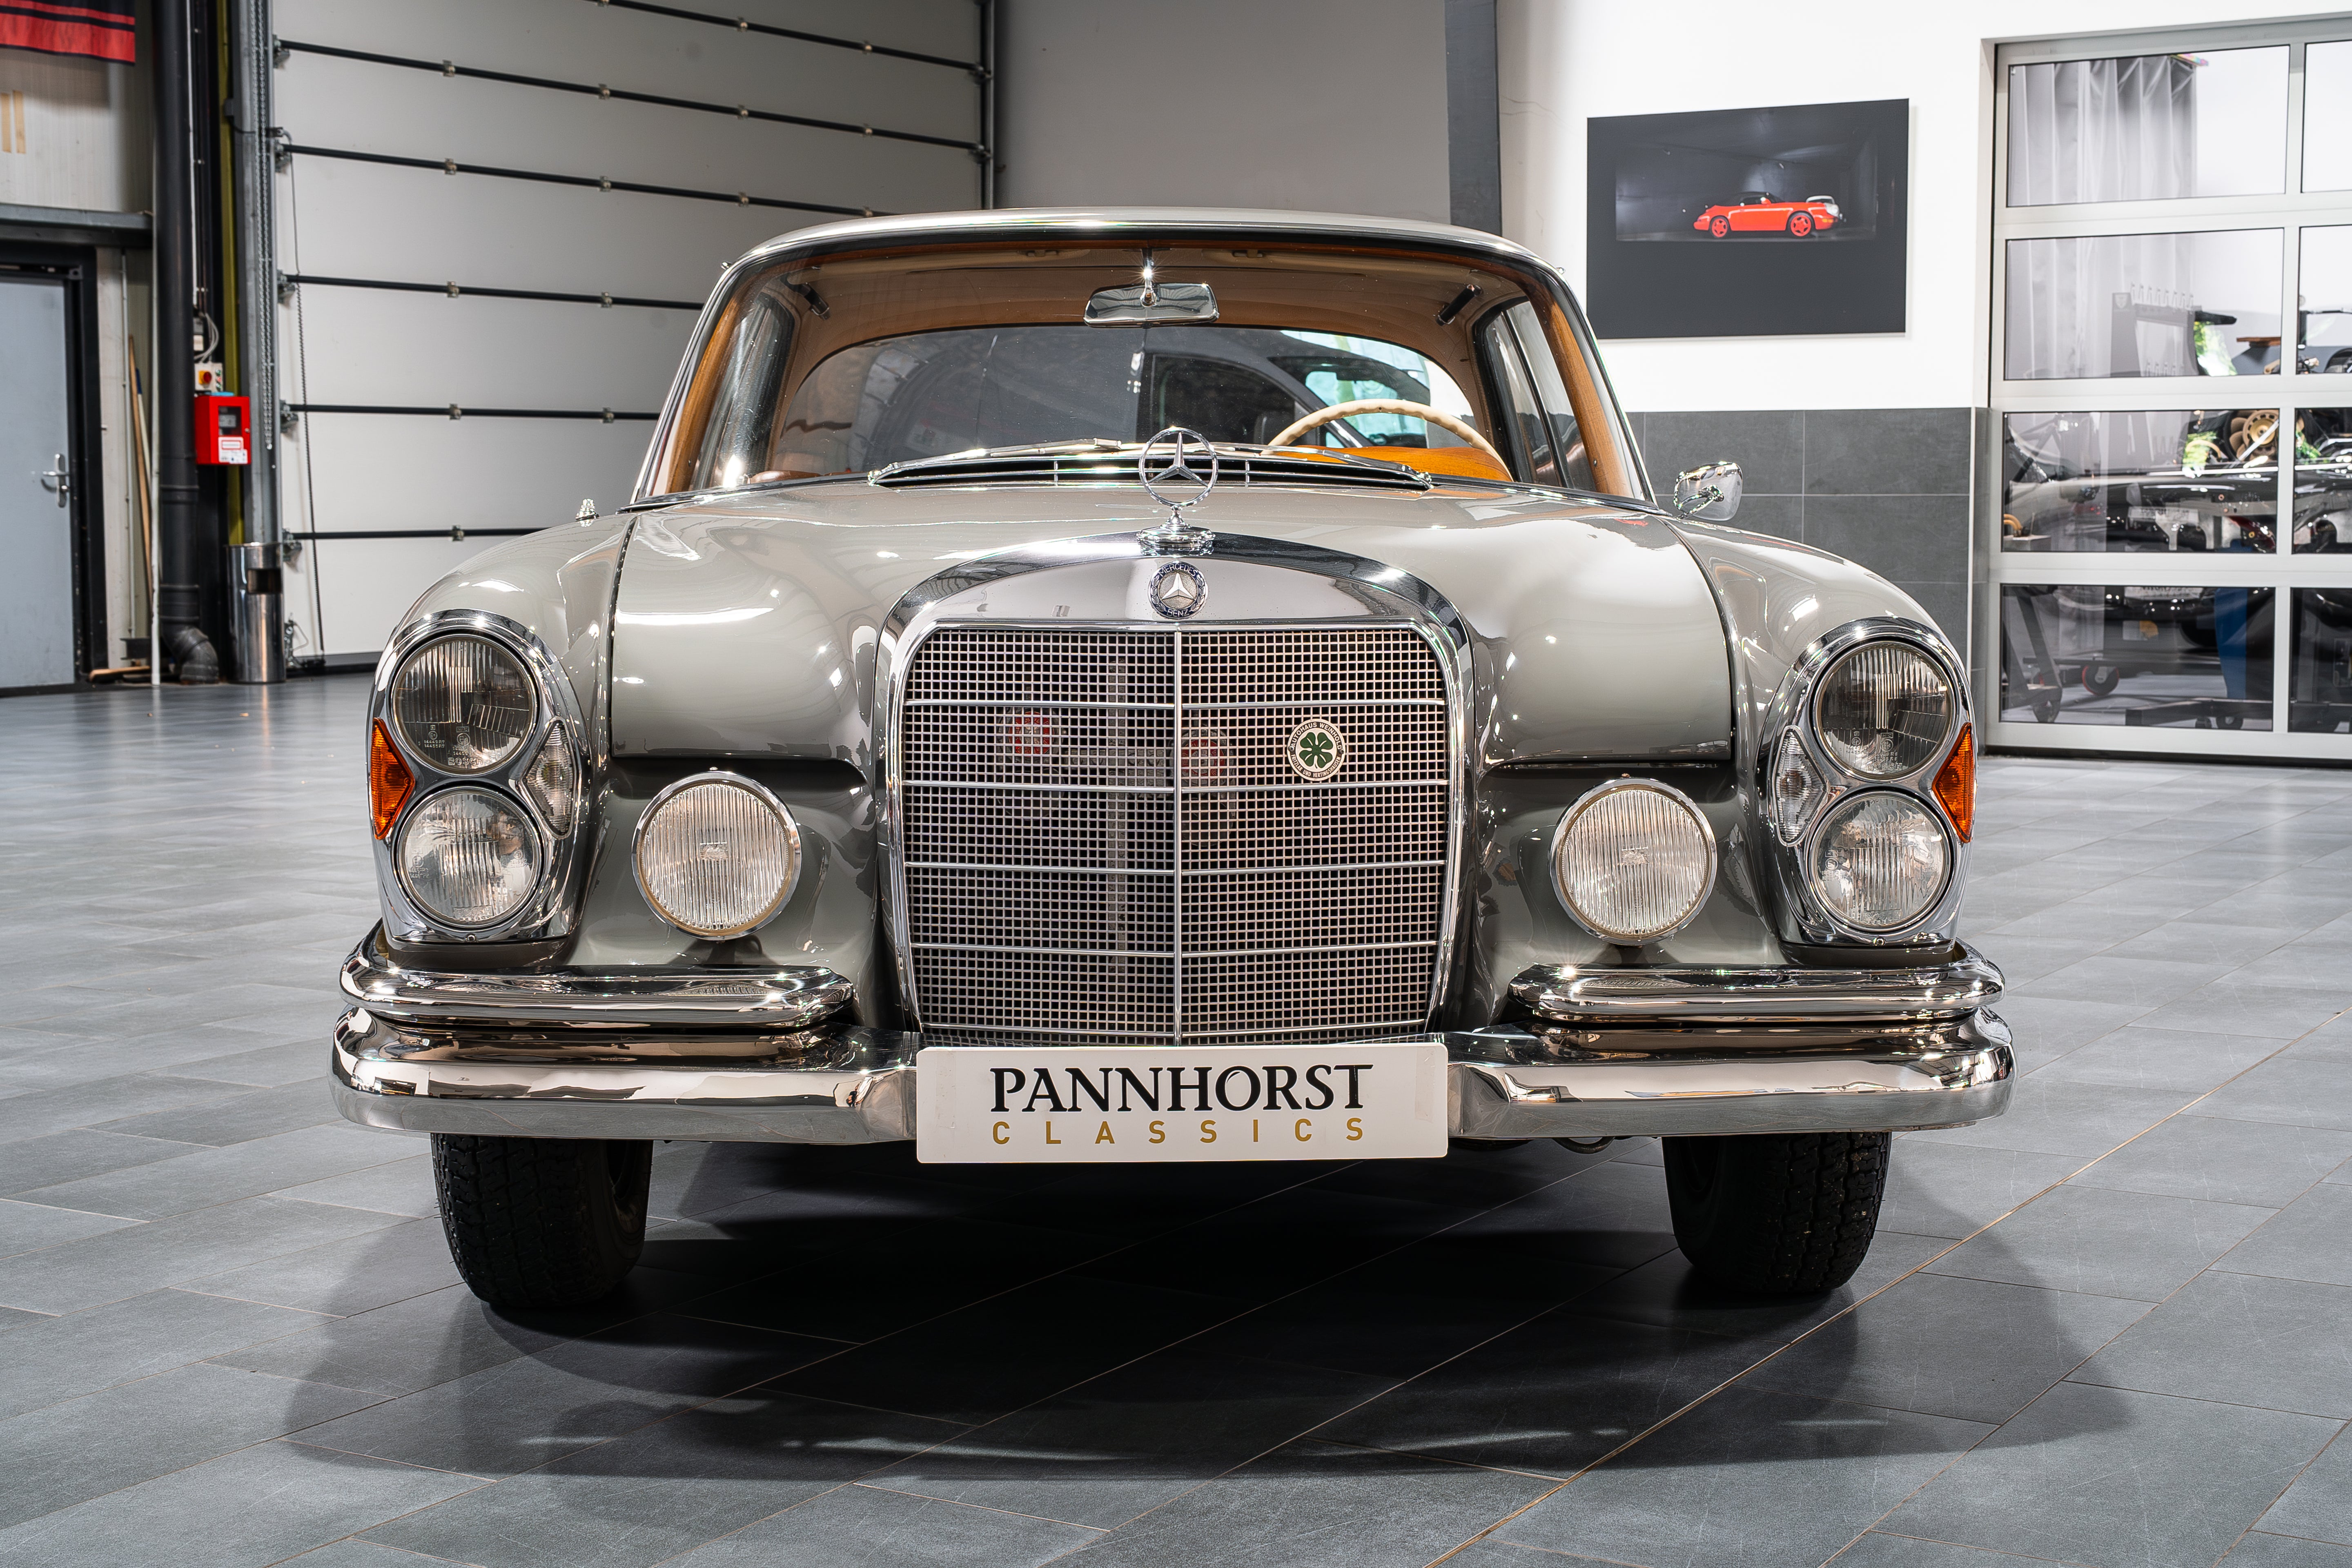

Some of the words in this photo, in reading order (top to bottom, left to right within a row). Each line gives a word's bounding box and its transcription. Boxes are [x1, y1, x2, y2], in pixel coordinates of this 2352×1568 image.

[1158, 563, 1197, 577] MERCEDES
[1167, 608, 1189, 617] BENZ
[1291, 722, 1317, 747] AUTOHAUS
[1319, 722, 1343, 749] WEINHOLD
[448, 757, 483, 766] BOSCH
[1291, 754, 1303, 772] FRITZLAR
[1313, 756, 1341, 778] HERTINGSHAUSEN
[1867, 762, 1903, 771] BOSCH
[455, 907, 491, 917] BOSCH
[990, 1064, 1374, 1112] PANNHORST
[993, 1117, 1363, 1144] CLASSICS
